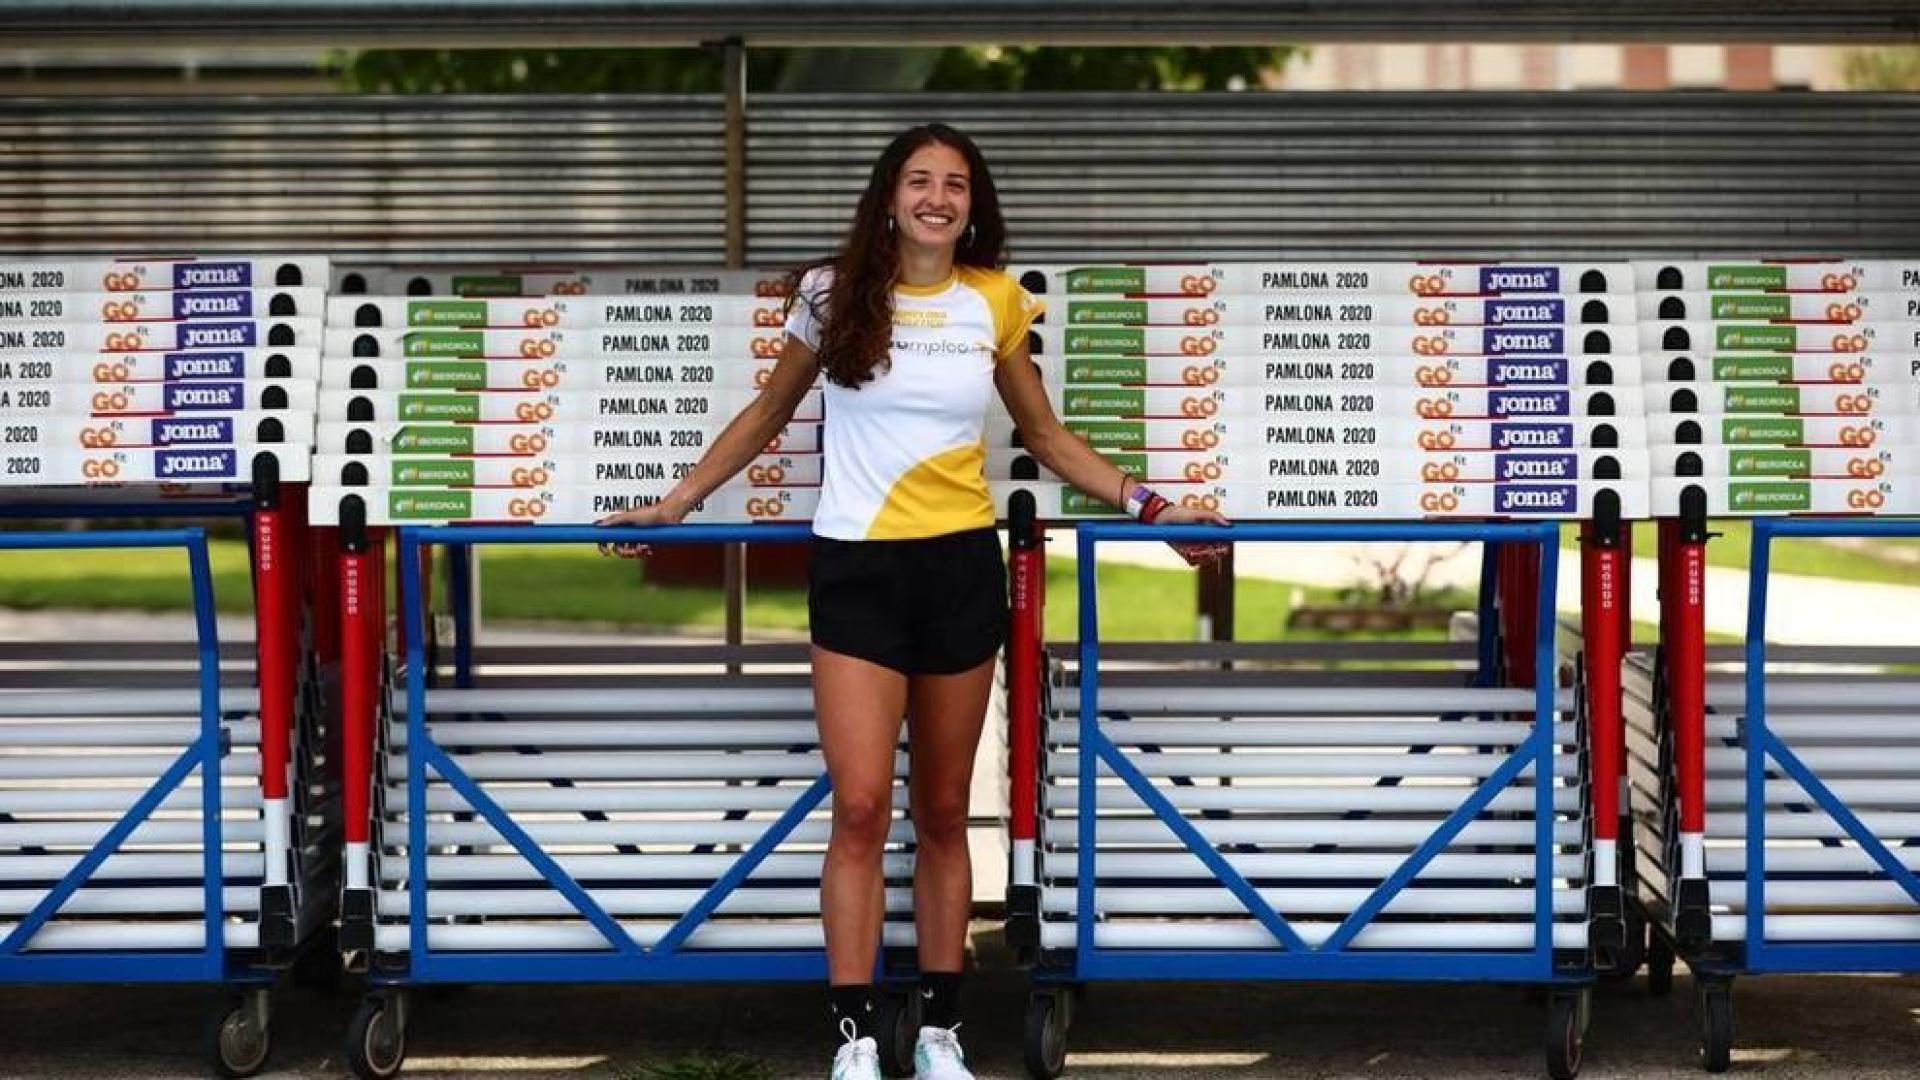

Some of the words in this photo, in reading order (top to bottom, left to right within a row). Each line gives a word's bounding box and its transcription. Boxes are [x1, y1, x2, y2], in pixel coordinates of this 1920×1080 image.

[33, 271, 63, 287] 2020
[104, 272, 140, 290] GO
[1181, 275, 1216, 294] GO
[1262, 273, 1329, 288] PAMLONA
[1336, 273, 1368, 288] 2020
[1409, 276, 1445, 293] GO
[1822, 274, 1856, 291] GO
[30, 301, 62, 316] 2020
[103, 302, 138, 319] GO
[606, 306, 672, 322] PAMLONA
[680, 306, 712, 322] 2020
[1183, 308, 1218, 325] GO
[1266, 306, 1332, 321] PAMLONA
[1339, 306, 1372, 321] 2020
[1413, 308, 1449, 325] GO
[1826, 304, 1861, 320] GO
[524, 309, 559, 326] GO
[32, 331, 64, 347] 2020
[106, 333, 142, 350] GO
[520, 339, 555, 356] GO
[602, 336, 669, 351] PAMLONA
[677, 336, 709, 351] 2020
[1181, 336, 1216, 354] GO
[1264, 334, 1330, 349] PAMLONA
[1338, 334, 1370, 349] 2020
[1412, 336, 1448, 354] GO
[1832, 334, 1867, 351] GO
[19, 363, 52, 378] 2020
[93, 364, 128, 381] GO
[524, 370, 559, 387] GO
[606, 367, 673, 382] PAMLONA
[681, 367, 713, 382] 2020
[1183, 366, 1218, 384] GO
[1266, 364, 1332, 379] PAMLONA
[1341, 363, 1374, 379] 2020
[1416, 366, 1451, 384] GO
[1829, 363, 1864, 381] GO
[18, 392, 50, 406] 2020
[93, 393, 127, 410] GO
[600, 398, 668, 414] PAMLONA
[675, 398, 707, 413] 2020
[1181, 397, 1217, 415] GO
[1265, 396, 1333, 411] PAMLONA
[1341, 396, 1373, 411] 2020
[1836, 395, 1871, 412] GO
[516, 403, 551, 420] GO
[1416, 399, 1452, 417] GO
[5, 427, 37, 442] 2020
[80, 428, 115, 445] GO
[511, 434, 546, 452] GO
[594, 430, 662, 446] PAMLONA
[670, 430, 702, 446] 2020
[1183, 430, 1218, 448] GO
[1266, 428, 1334, 443] PAMLONA
[1342, 428, 1376, 443] 2020
[1418, 431, 1454, 449] GO
[1840, 427, 1875, 444] GO
[7, 458, 39, 473] 2020
[83, 459, 119, 477] GO
[596, 463, 665, 479] PAMLONA
[749, 465, 784, 483] GO
[1184, 462, 1221, 480] GO
[1269, 460, 1338, 476] PAMLONA
[1346, 459, 1379, 476] 2020
[1422, 462, 1458, 481] GO
[1848, 458, 1883, 476] GO
[512, 467, 547, 485] GO
[509, 499, 545, 516] GO
[747, 498, 784, 516] GO
[1182, 494, 1218, 511] GO
[1268, 491, 1337, 507] PAMLONA
[1344, 491, 1378, 506] 2020
[1421, 493, 1458, 511] GO
[1848, 490, 1883, 508] GO
